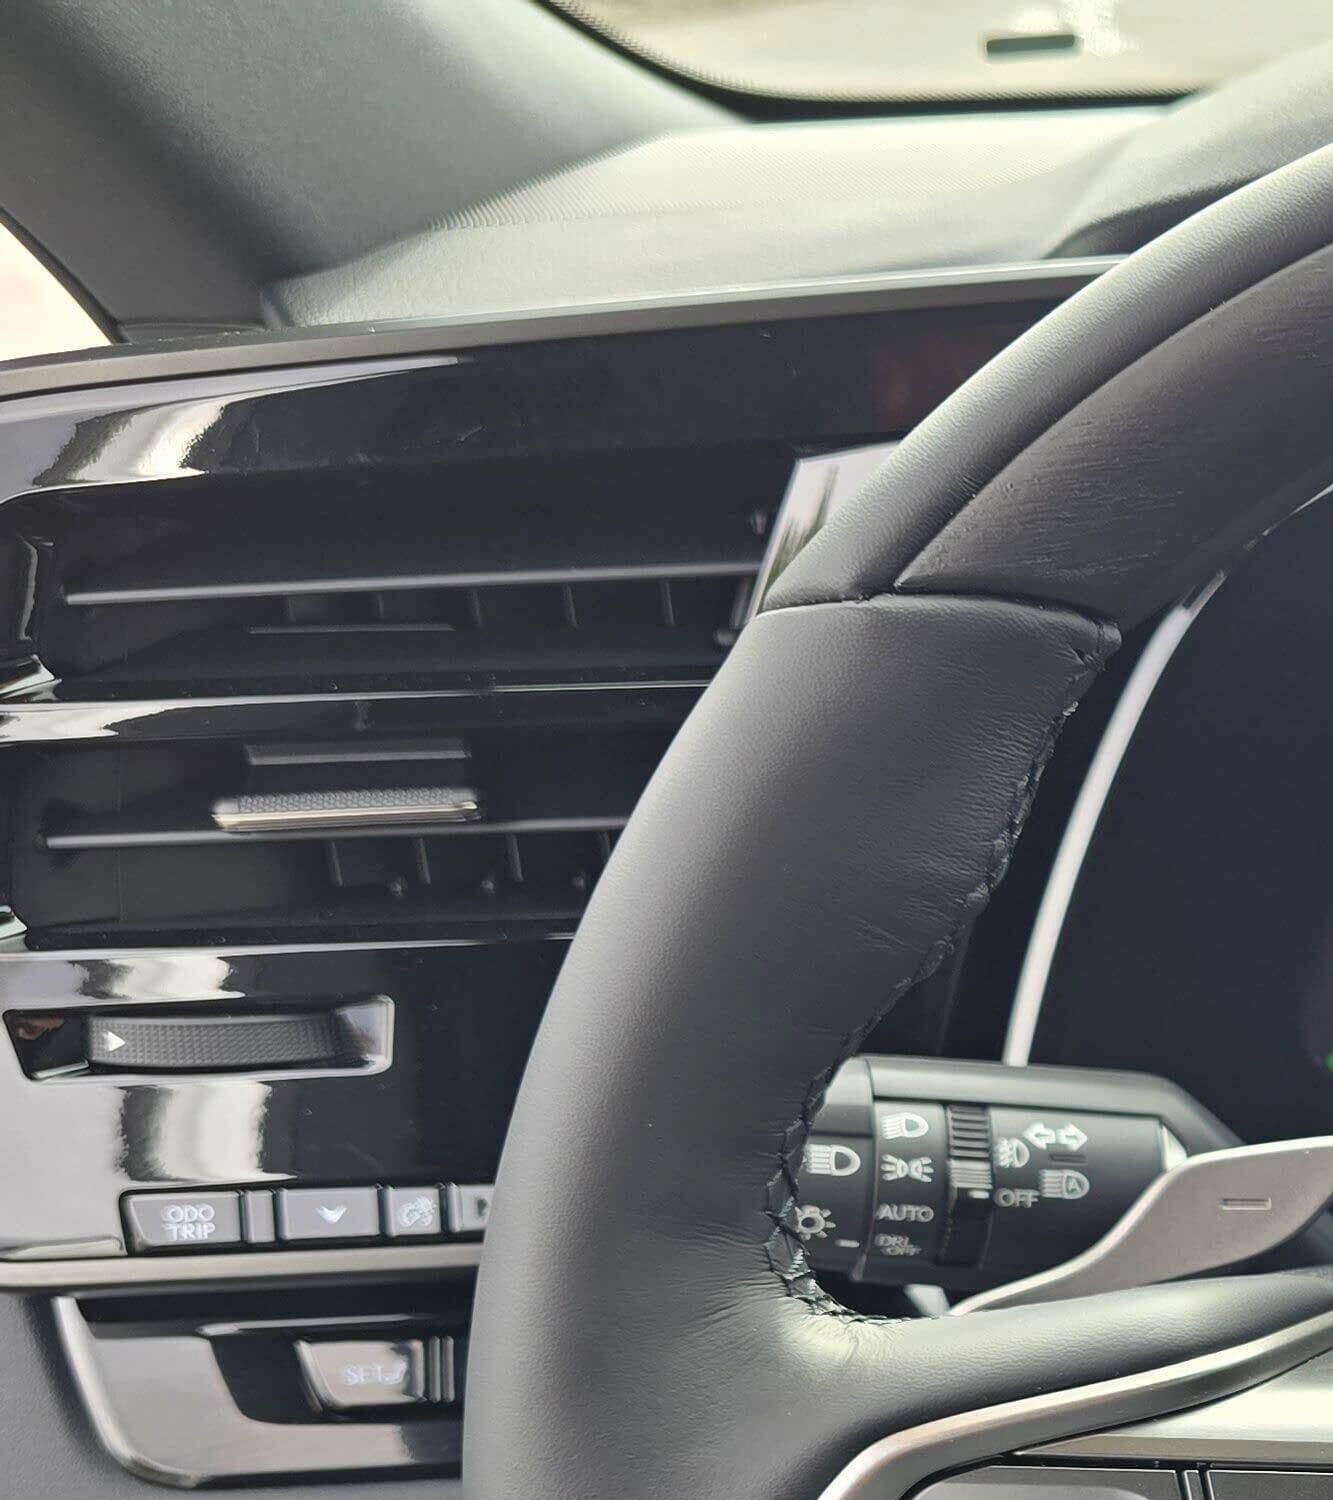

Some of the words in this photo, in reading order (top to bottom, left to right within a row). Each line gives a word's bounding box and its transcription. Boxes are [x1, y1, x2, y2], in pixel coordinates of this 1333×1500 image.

[996, 1187, 1039, 1209] OFF
[164, 1204, 216, 1223] ODO
[876, 1203, 934, 1224] AUTO
[166, 1222, 217, 1243] TRIP
